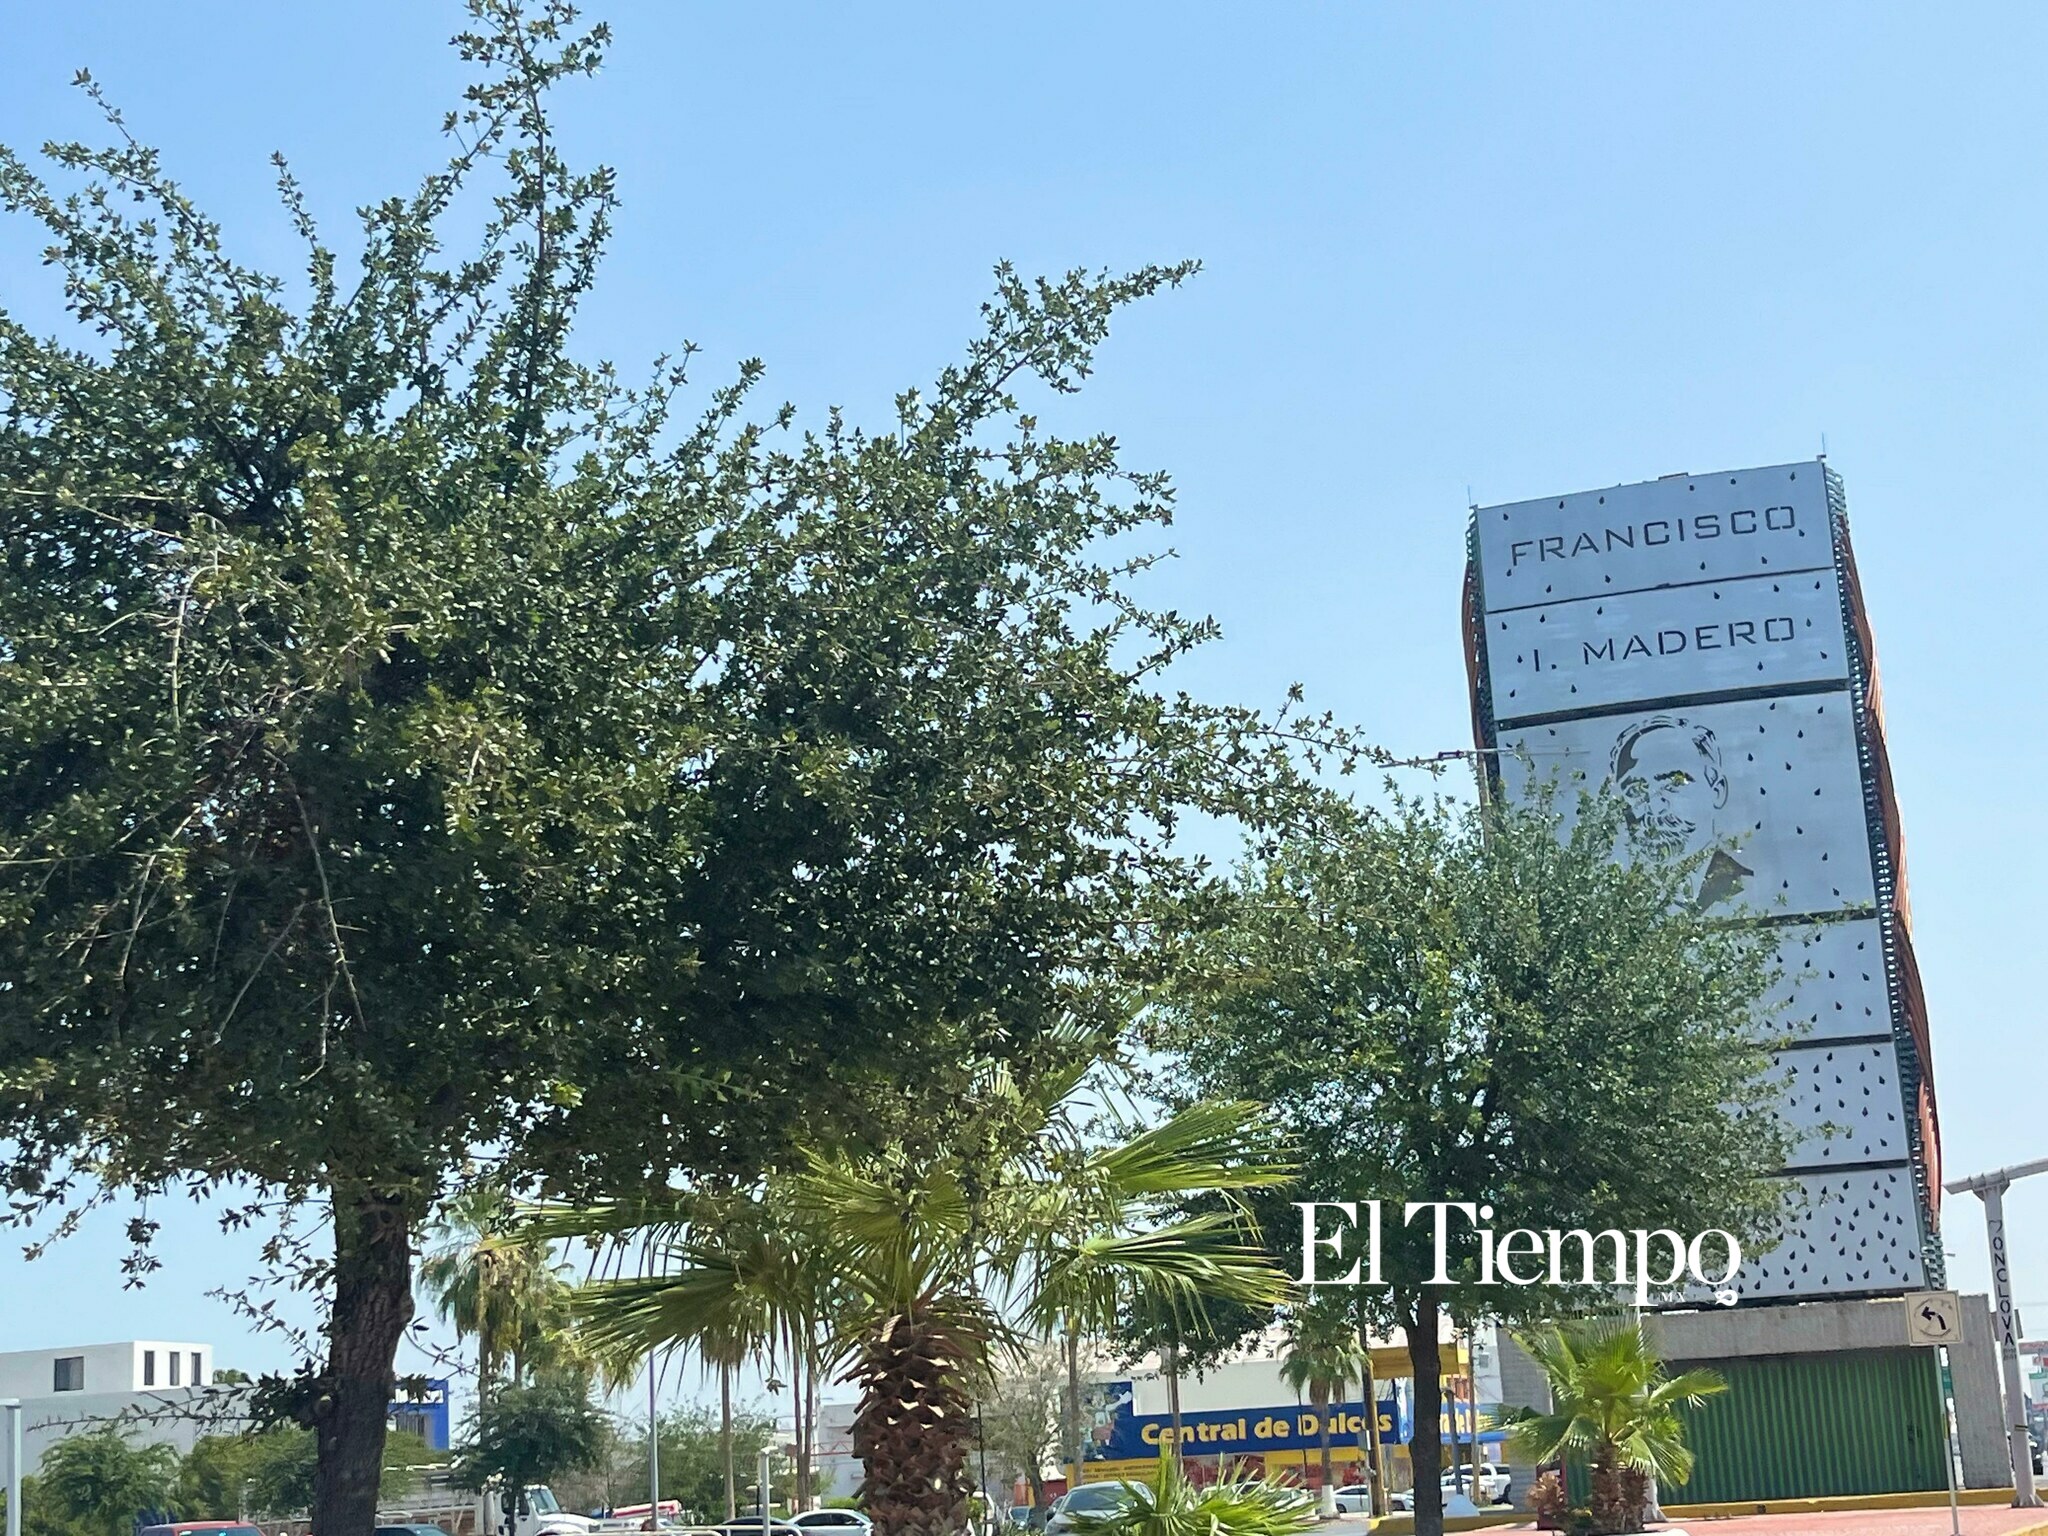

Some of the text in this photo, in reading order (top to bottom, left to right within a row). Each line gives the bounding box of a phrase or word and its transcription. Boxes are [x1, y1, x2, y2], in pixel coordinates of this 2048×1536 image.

[1511, 506, 1796, 566] FRANCISCO
[1533, 617, 1795, 672] I. MADERO
[1141, 1412, 1392, 1445] Central de Dulcs
